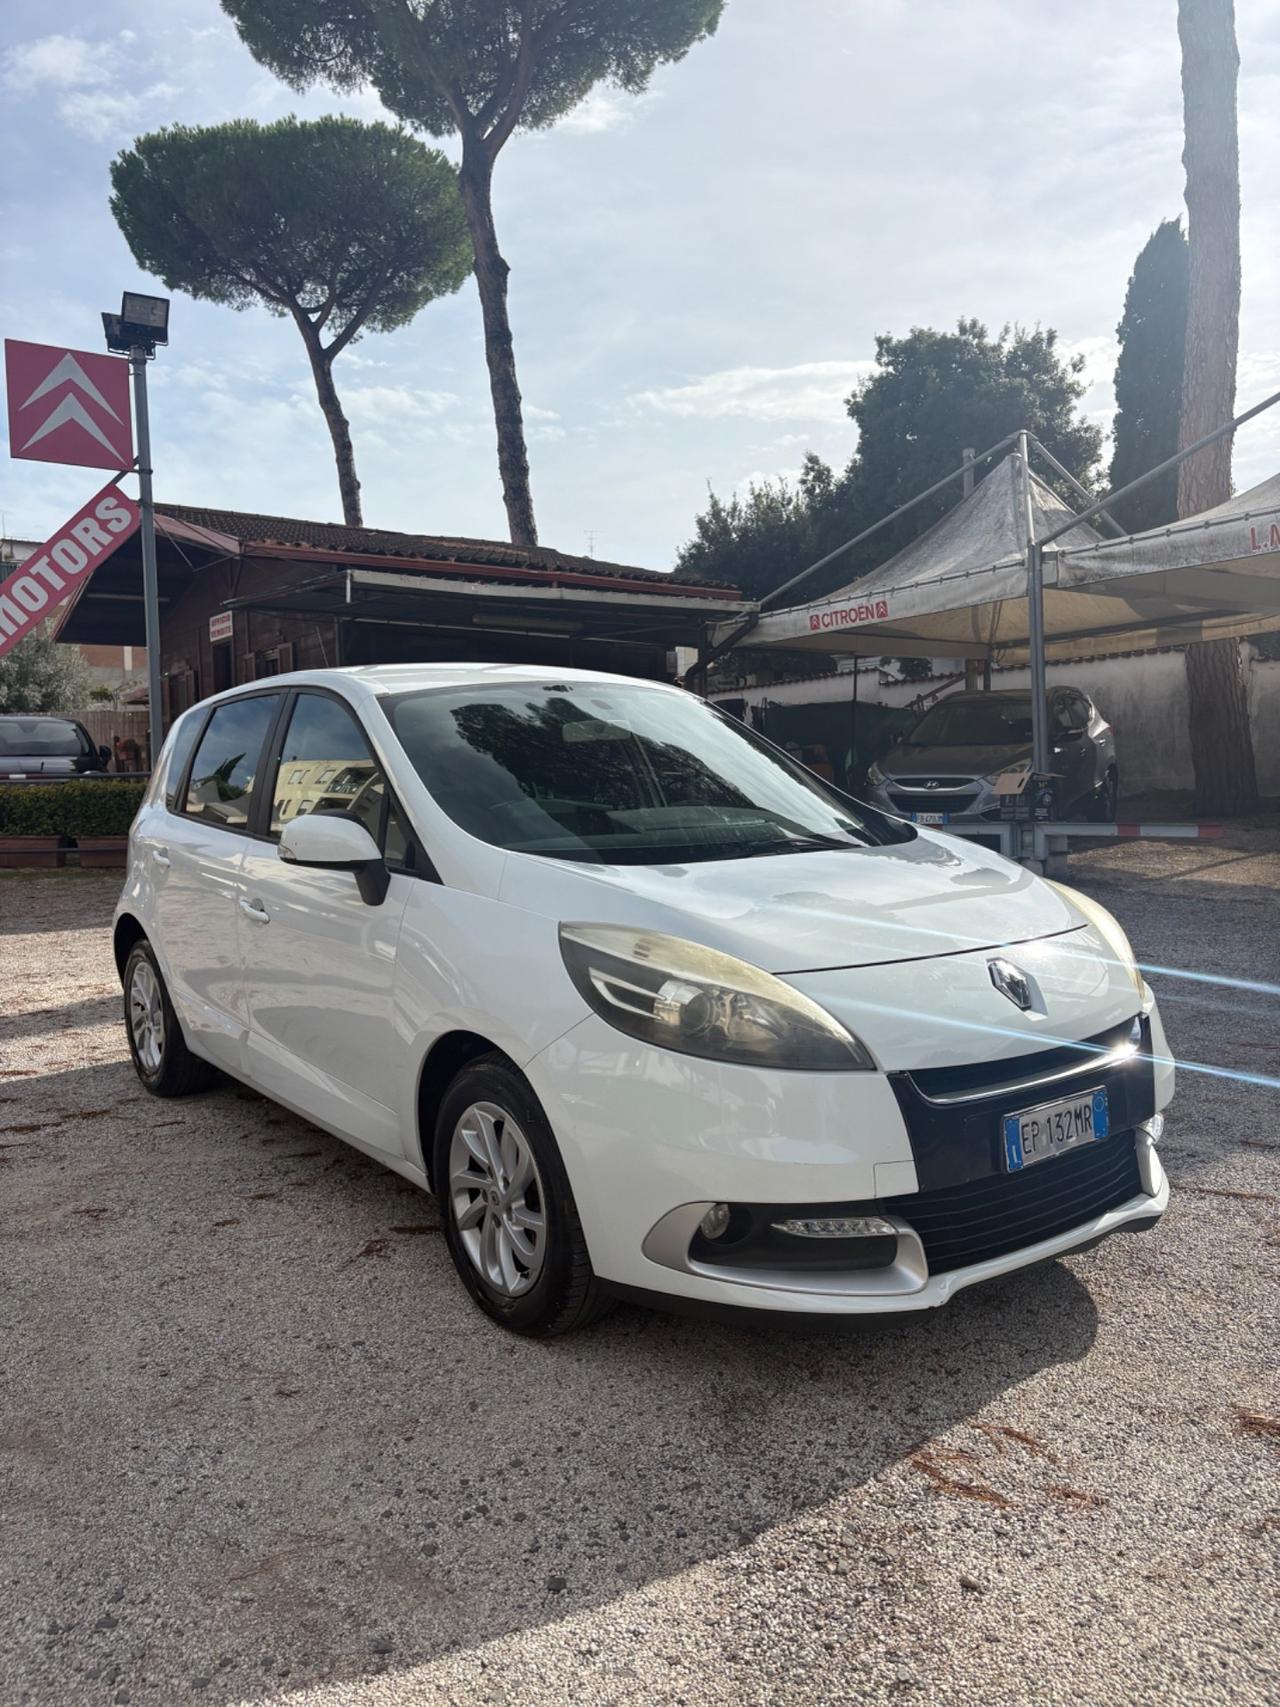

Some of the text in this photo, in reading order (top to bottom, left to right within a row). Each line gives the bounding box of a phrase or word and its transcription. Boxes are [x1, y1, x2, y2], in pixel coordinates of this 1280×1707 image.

[821, 602, 875, 628] CITROËN
[1021, 1104, 1093, 1155] EP 132MR
